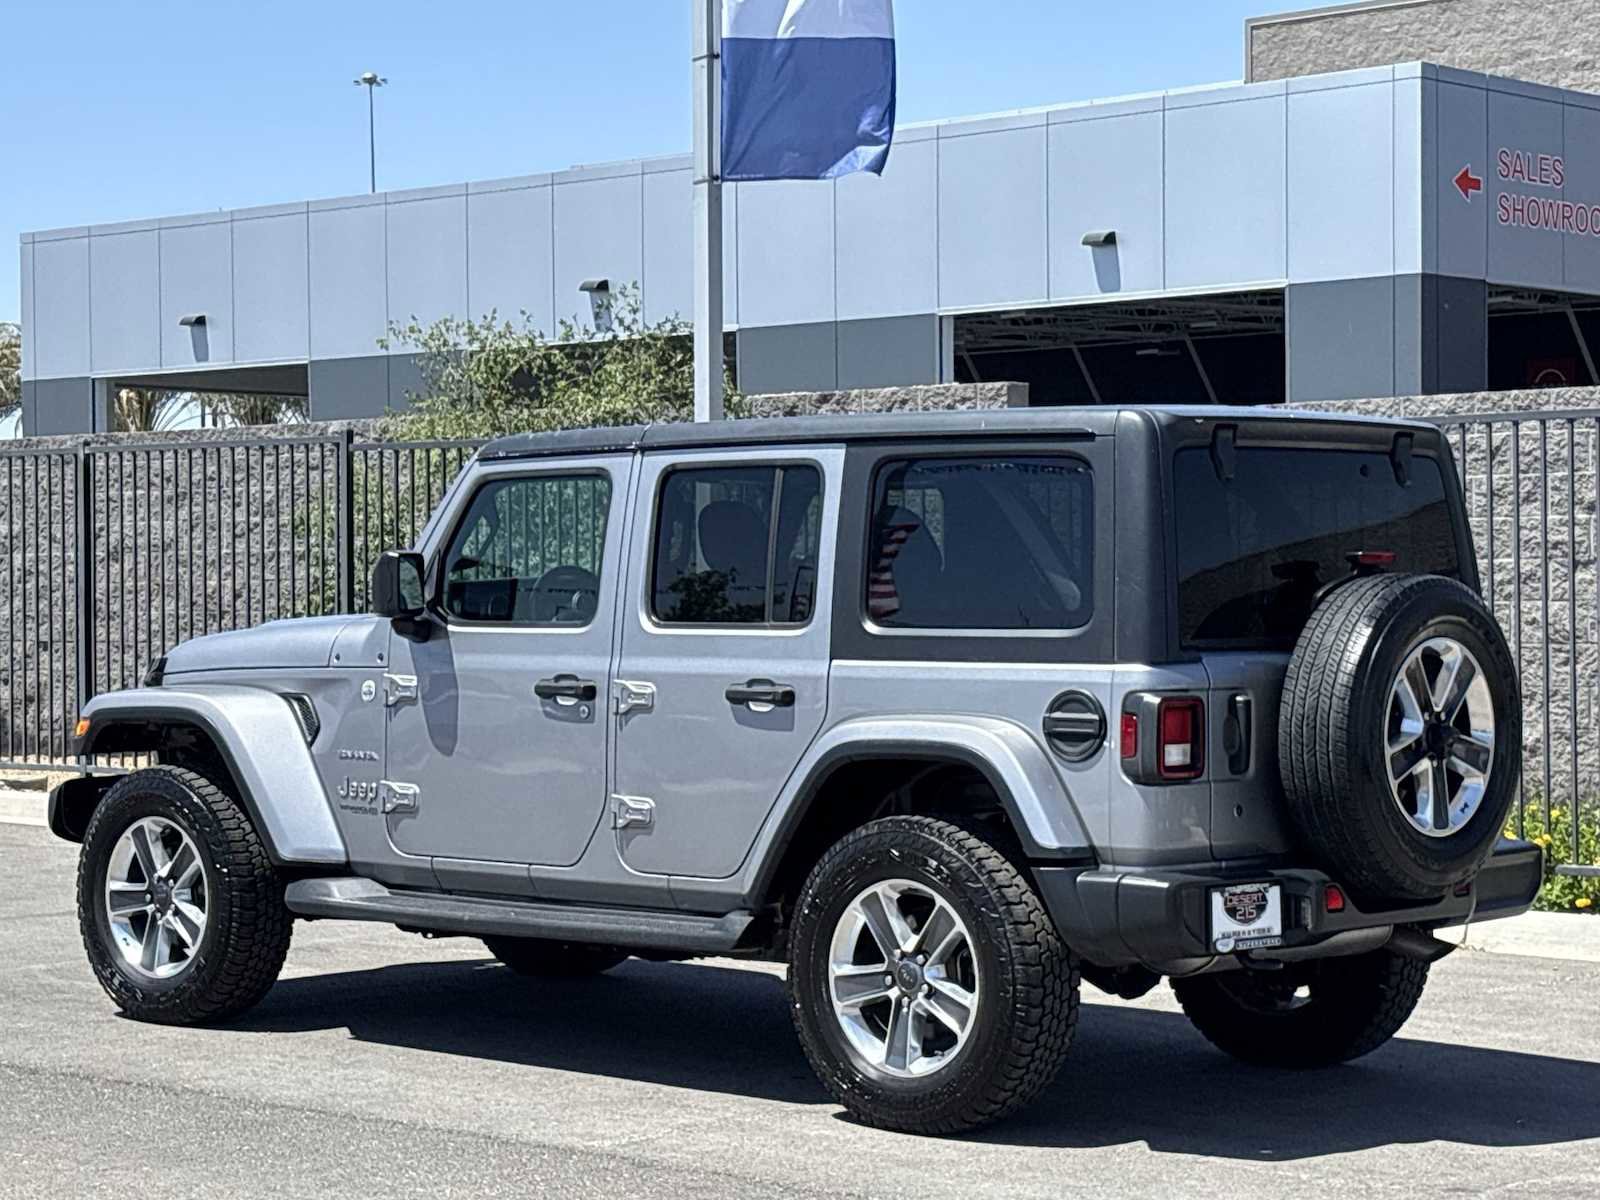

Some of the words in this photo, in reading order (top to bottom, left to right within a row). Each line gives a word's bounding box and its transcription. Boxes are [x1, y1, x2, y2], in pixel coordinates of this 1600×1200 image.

[1498, 148, 1564, 188] SALES
[337, 776, 378, 804] Jeep
[1227, 893, 1264, 905] DESERT
[1236, 905, 1257, 920] 215
